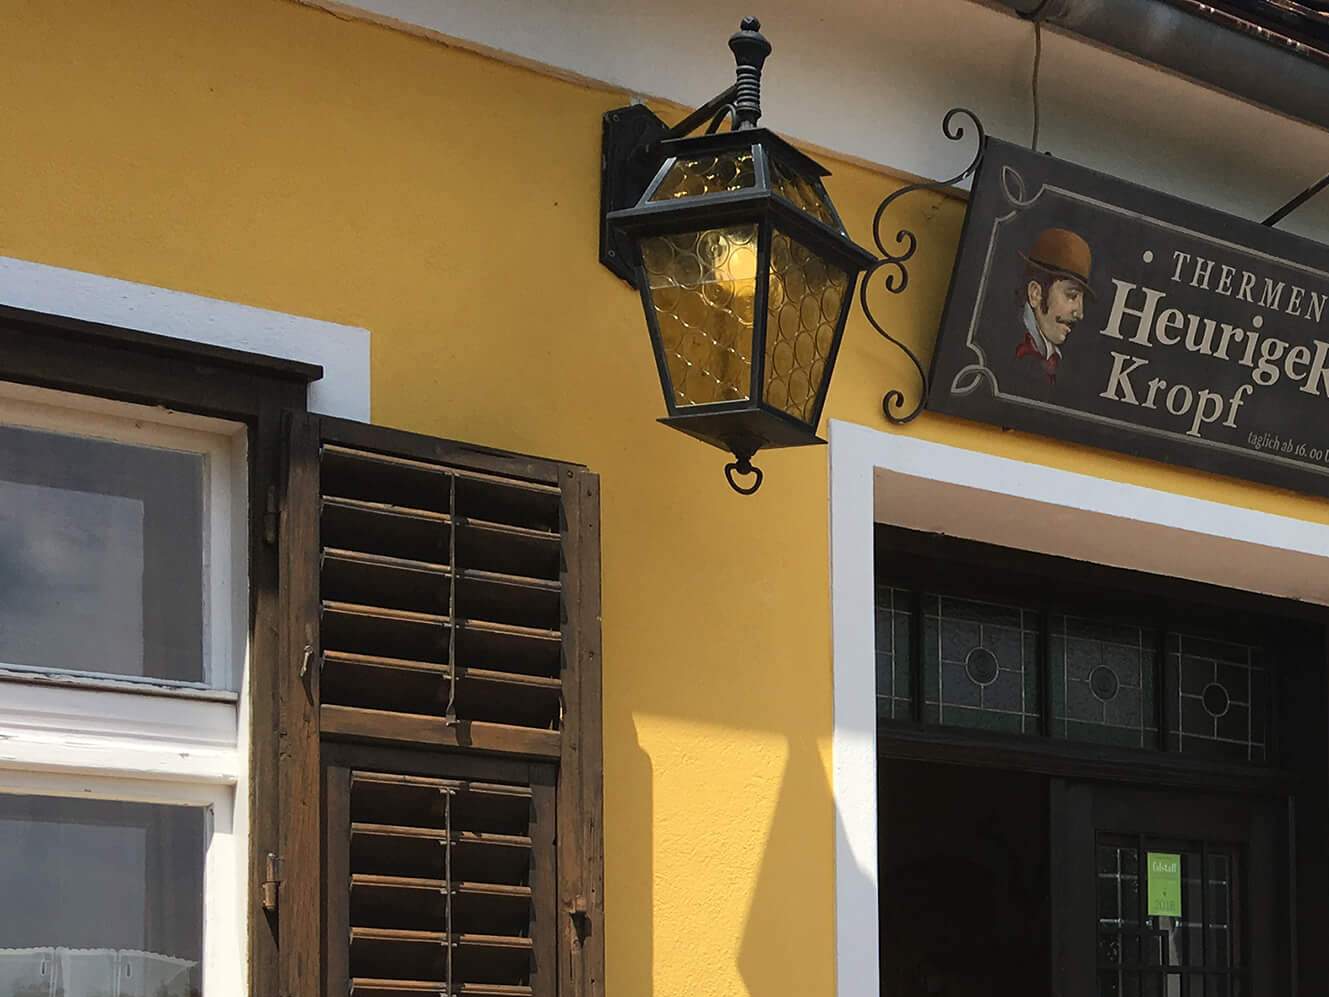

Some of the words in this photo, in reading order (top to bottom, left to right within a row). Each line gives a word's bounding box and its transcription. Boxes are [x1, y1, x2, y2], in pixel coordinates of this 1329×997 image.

[1170, 250, 1329, 324] THERMEN
[1100, 351, 1253, 437] Kropf
[1281, 439, 1294, 453] ab
